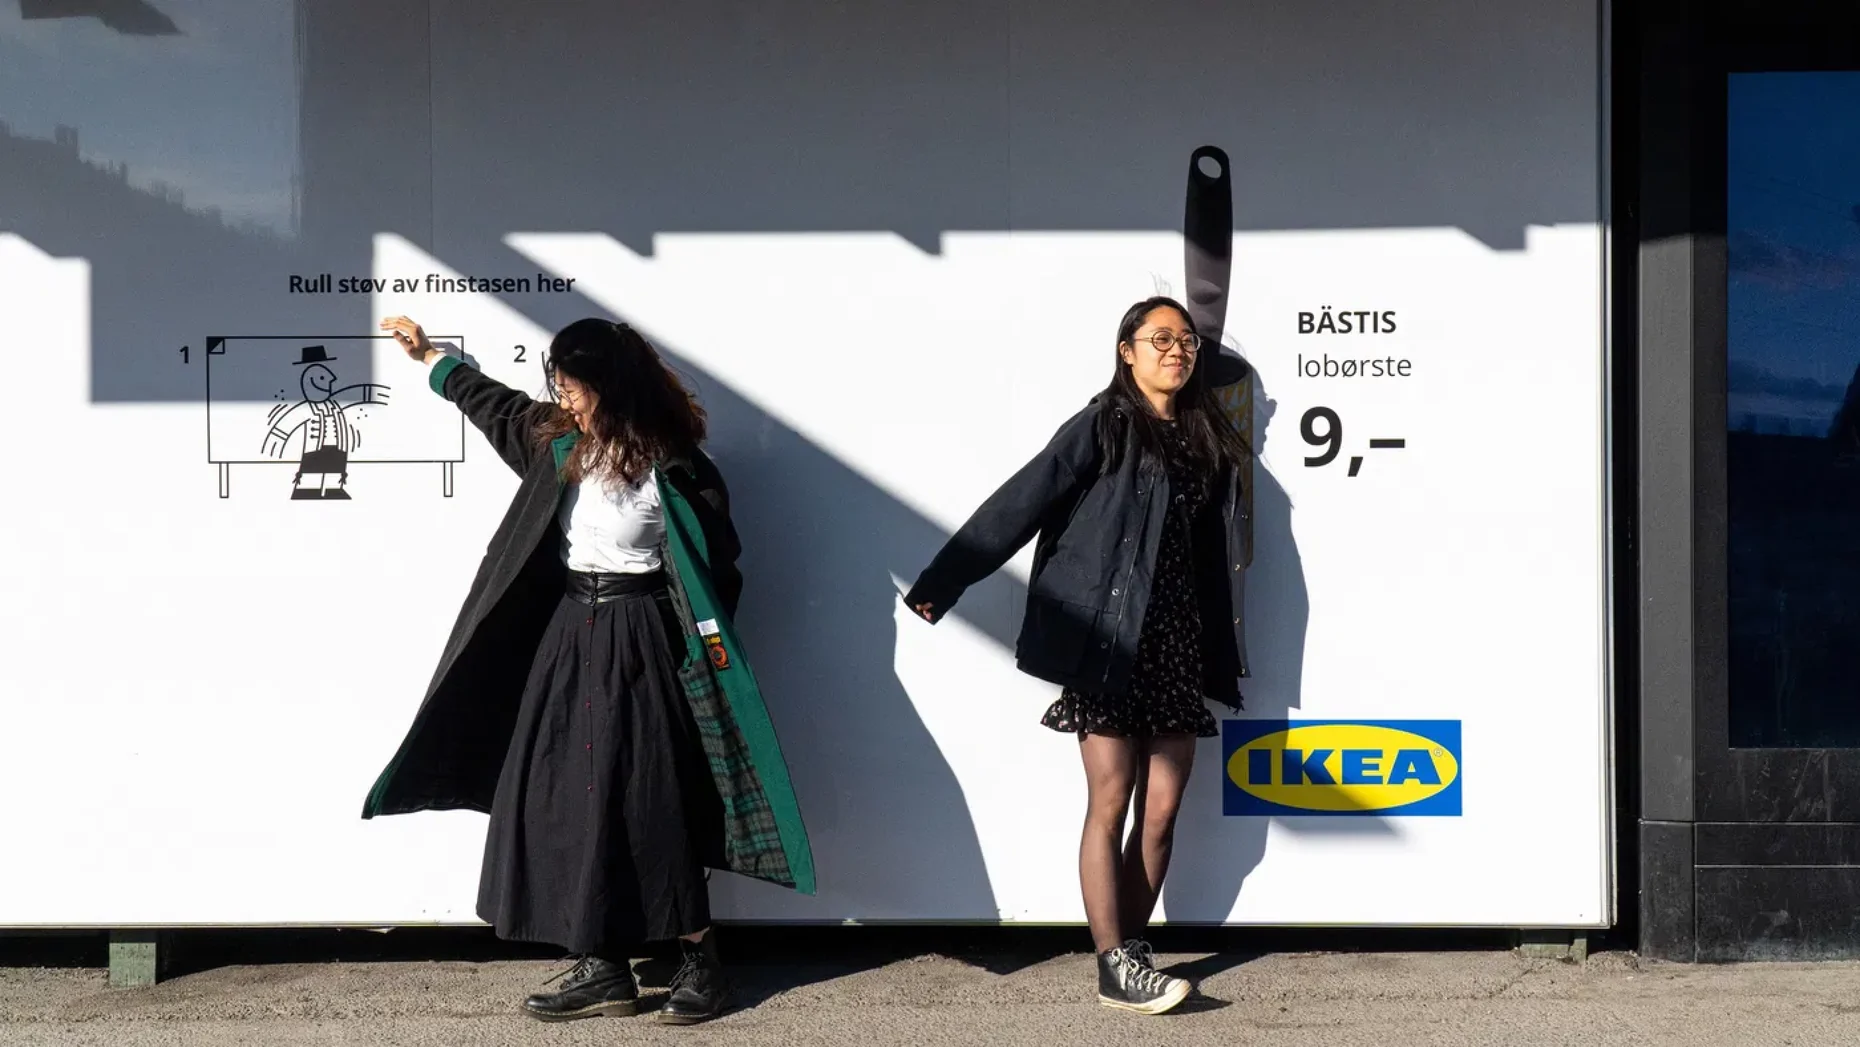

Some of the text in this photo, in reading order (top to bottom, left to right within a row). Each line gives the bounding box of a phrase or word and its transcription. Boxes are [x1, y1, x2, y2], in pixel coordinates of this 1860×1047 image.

[289, 273, 576, 293] Rull støv av finstasen her
[1298, 305, 1397, 334] BÄSTIS
[179, 345, 190, 364] 1
[513, 345, 527, 363] 2
[1298, 353, 1412, 378] lobørste
[1248, 748, 1442, 785] IKEA
